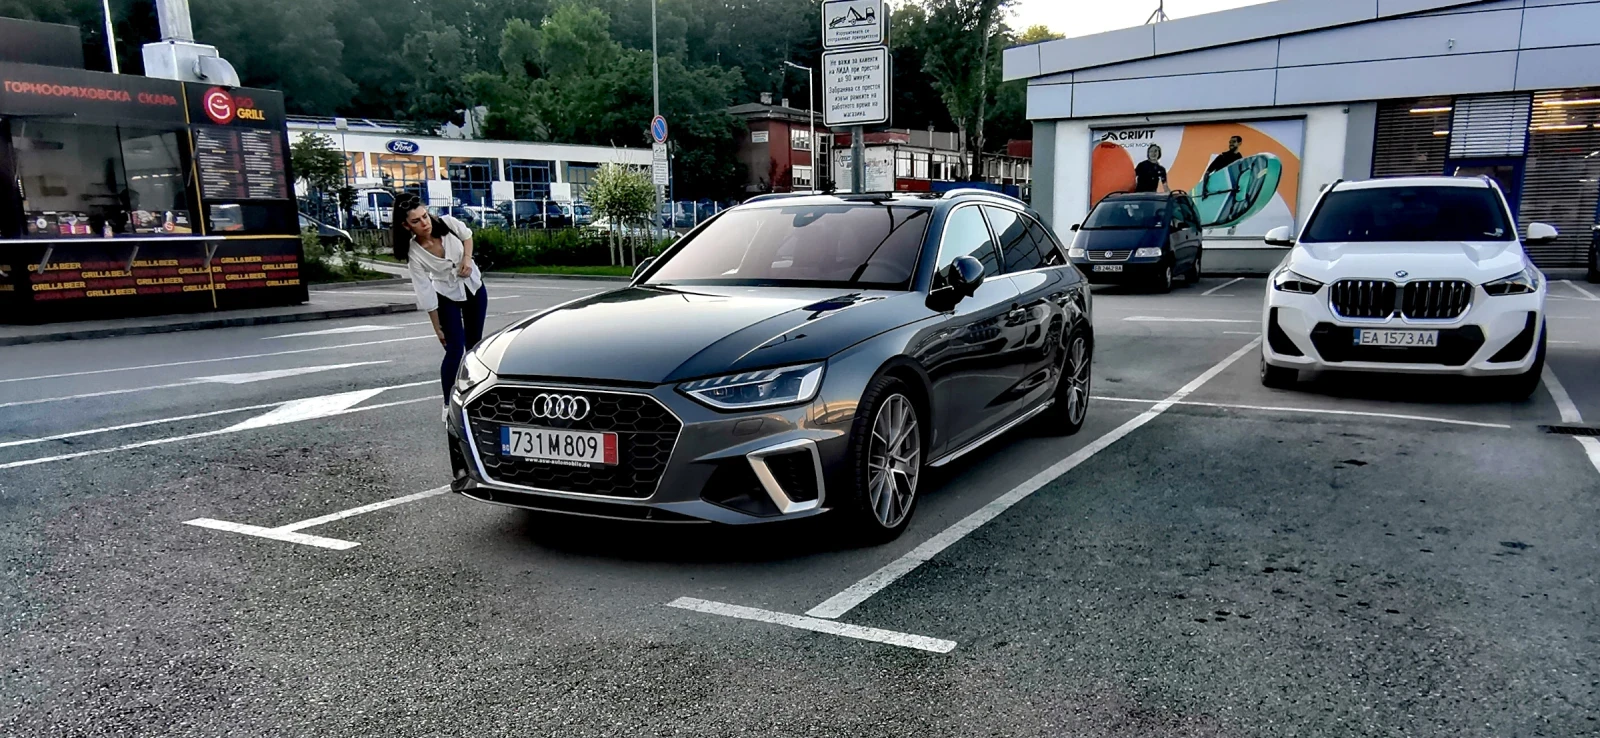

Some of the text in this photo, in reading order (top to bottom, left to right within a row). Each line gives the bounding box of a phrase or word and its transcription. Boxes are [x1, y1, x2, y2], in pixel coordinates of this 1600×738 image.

[4, 80, 178, 105] ГОРНООРЯХОВСКА СКАРА
[237, 107, 266, 121] GRILL
[1119, 130, 1156, 140] CRIVIT
[393, 141, 413, 152] Ford
[1361, 331, 1434, 345] EA 1573 AA
